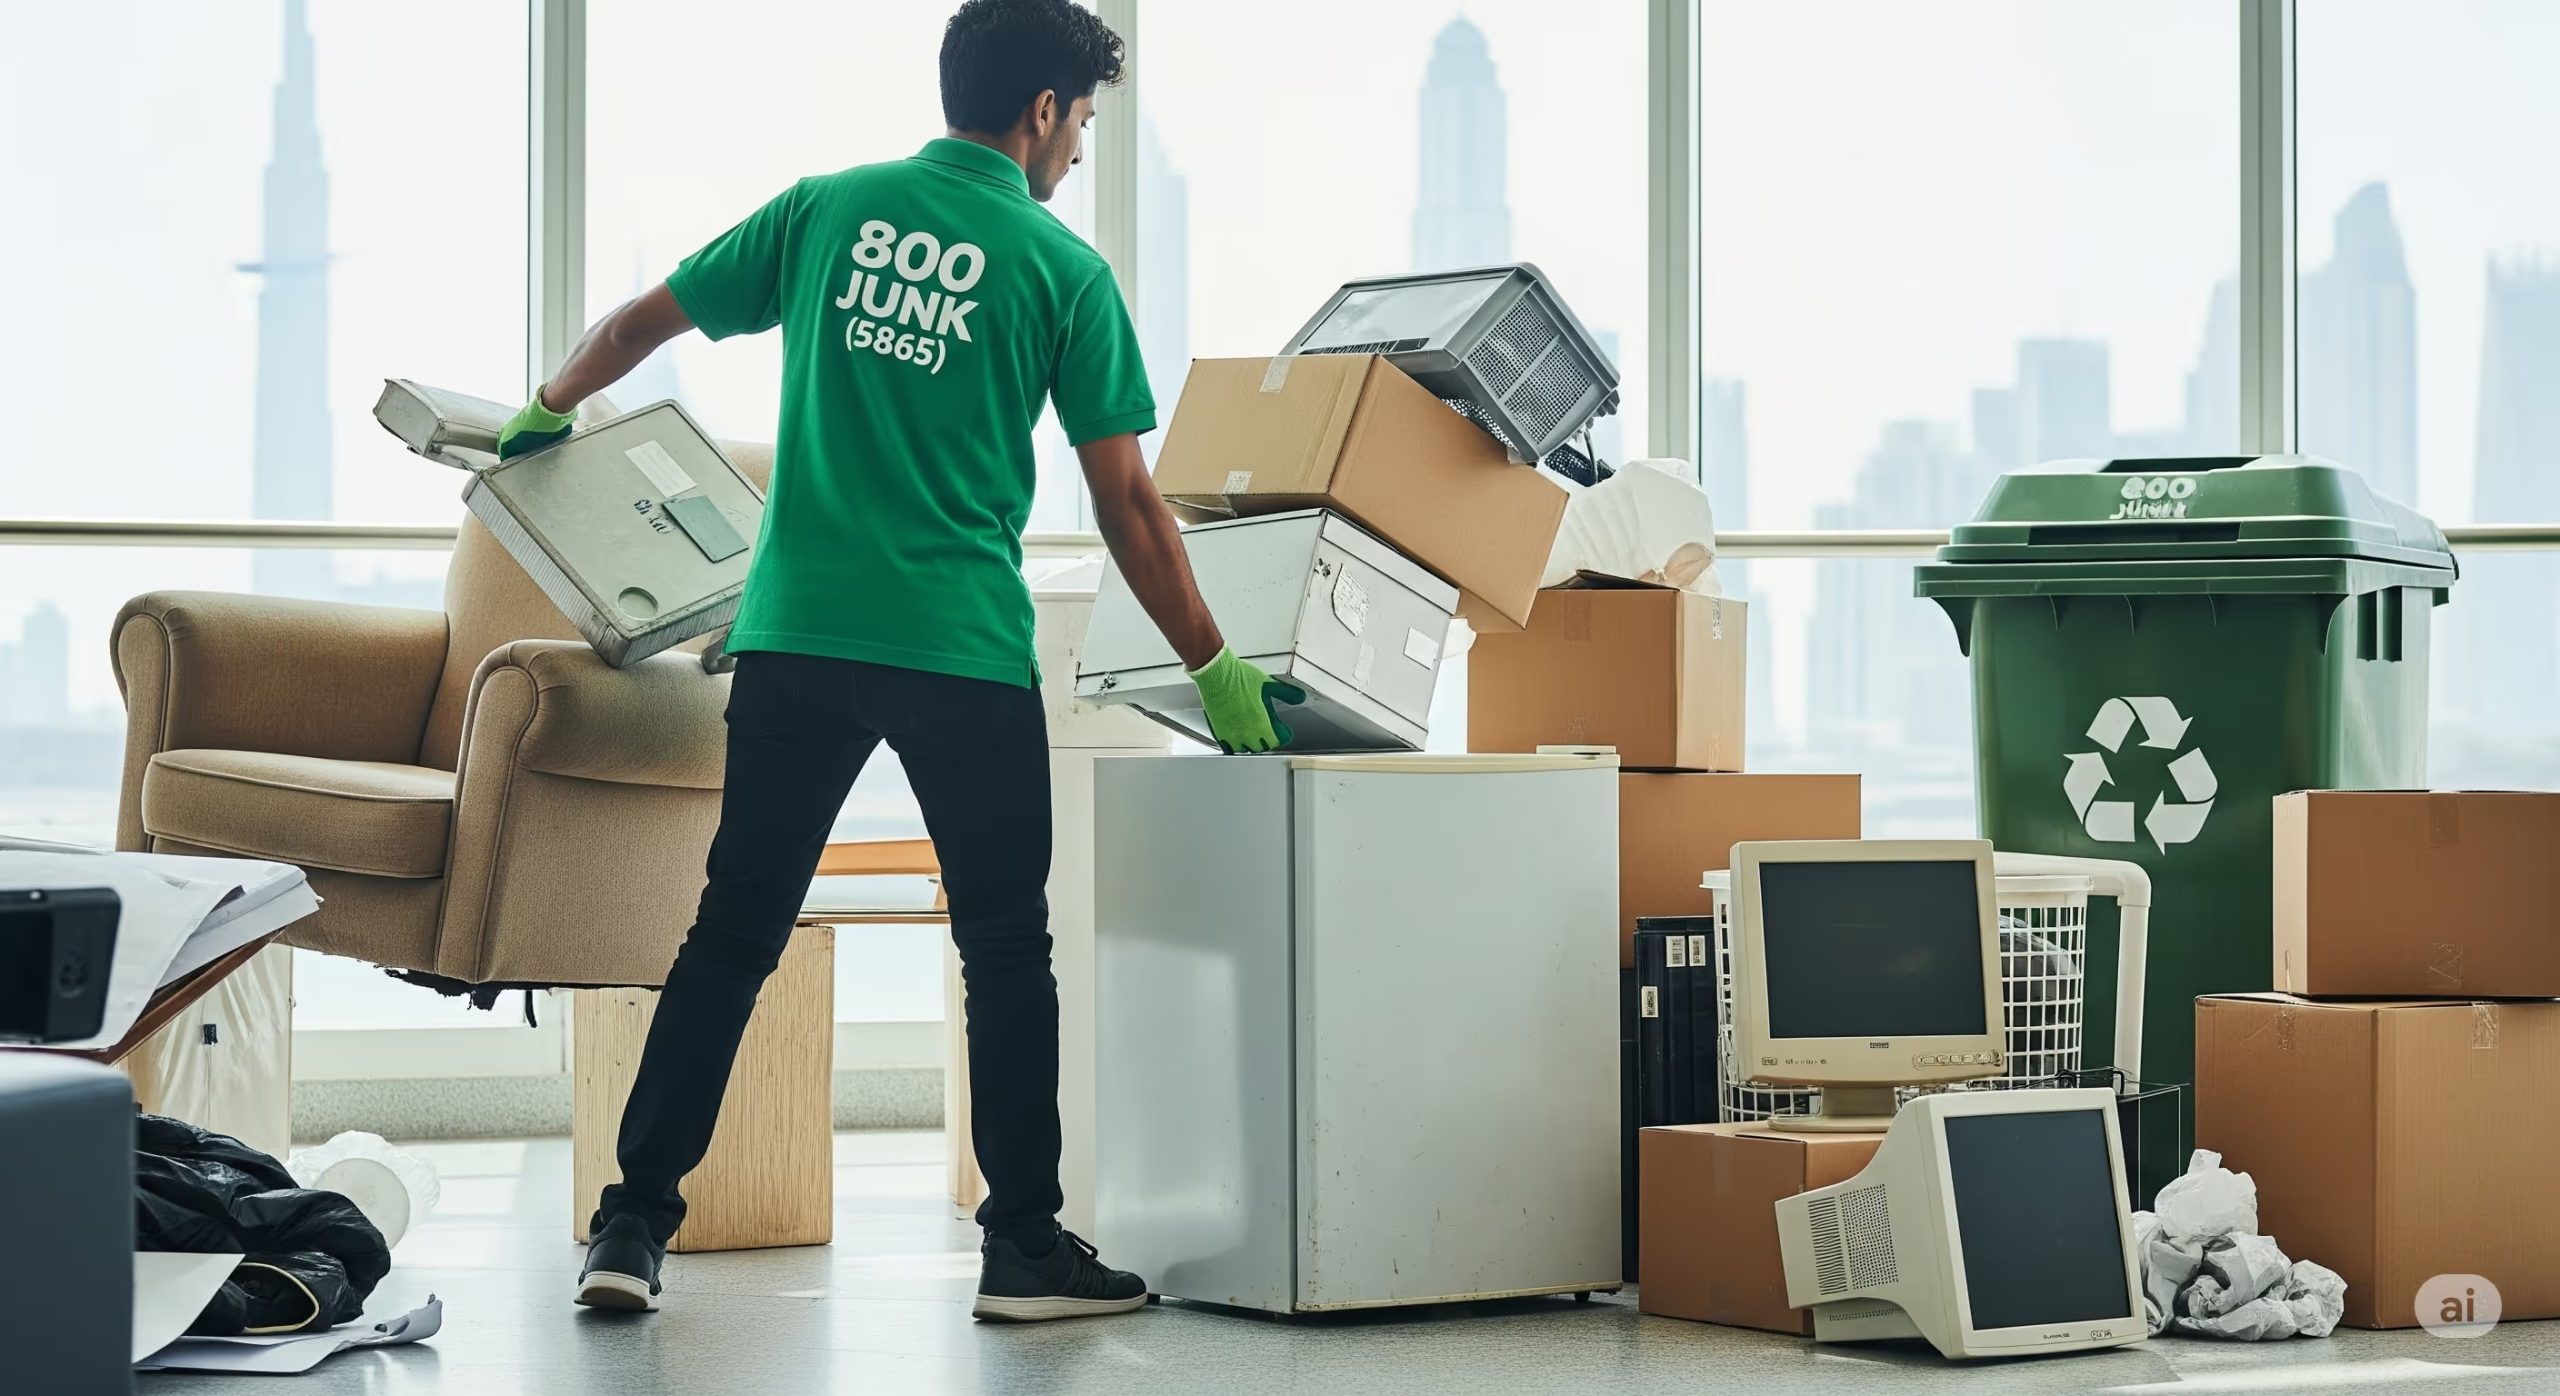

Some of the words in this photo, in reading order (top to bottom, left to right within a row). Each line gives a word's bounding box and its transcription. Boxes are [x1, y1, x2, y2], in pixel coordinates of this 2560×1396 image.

[852, 219, 986, 293] 800
[835, 269, 980, 343] JUNK
[845, 316, 946, 375] (5865)
[2120, 476, 2197, 500] 800
